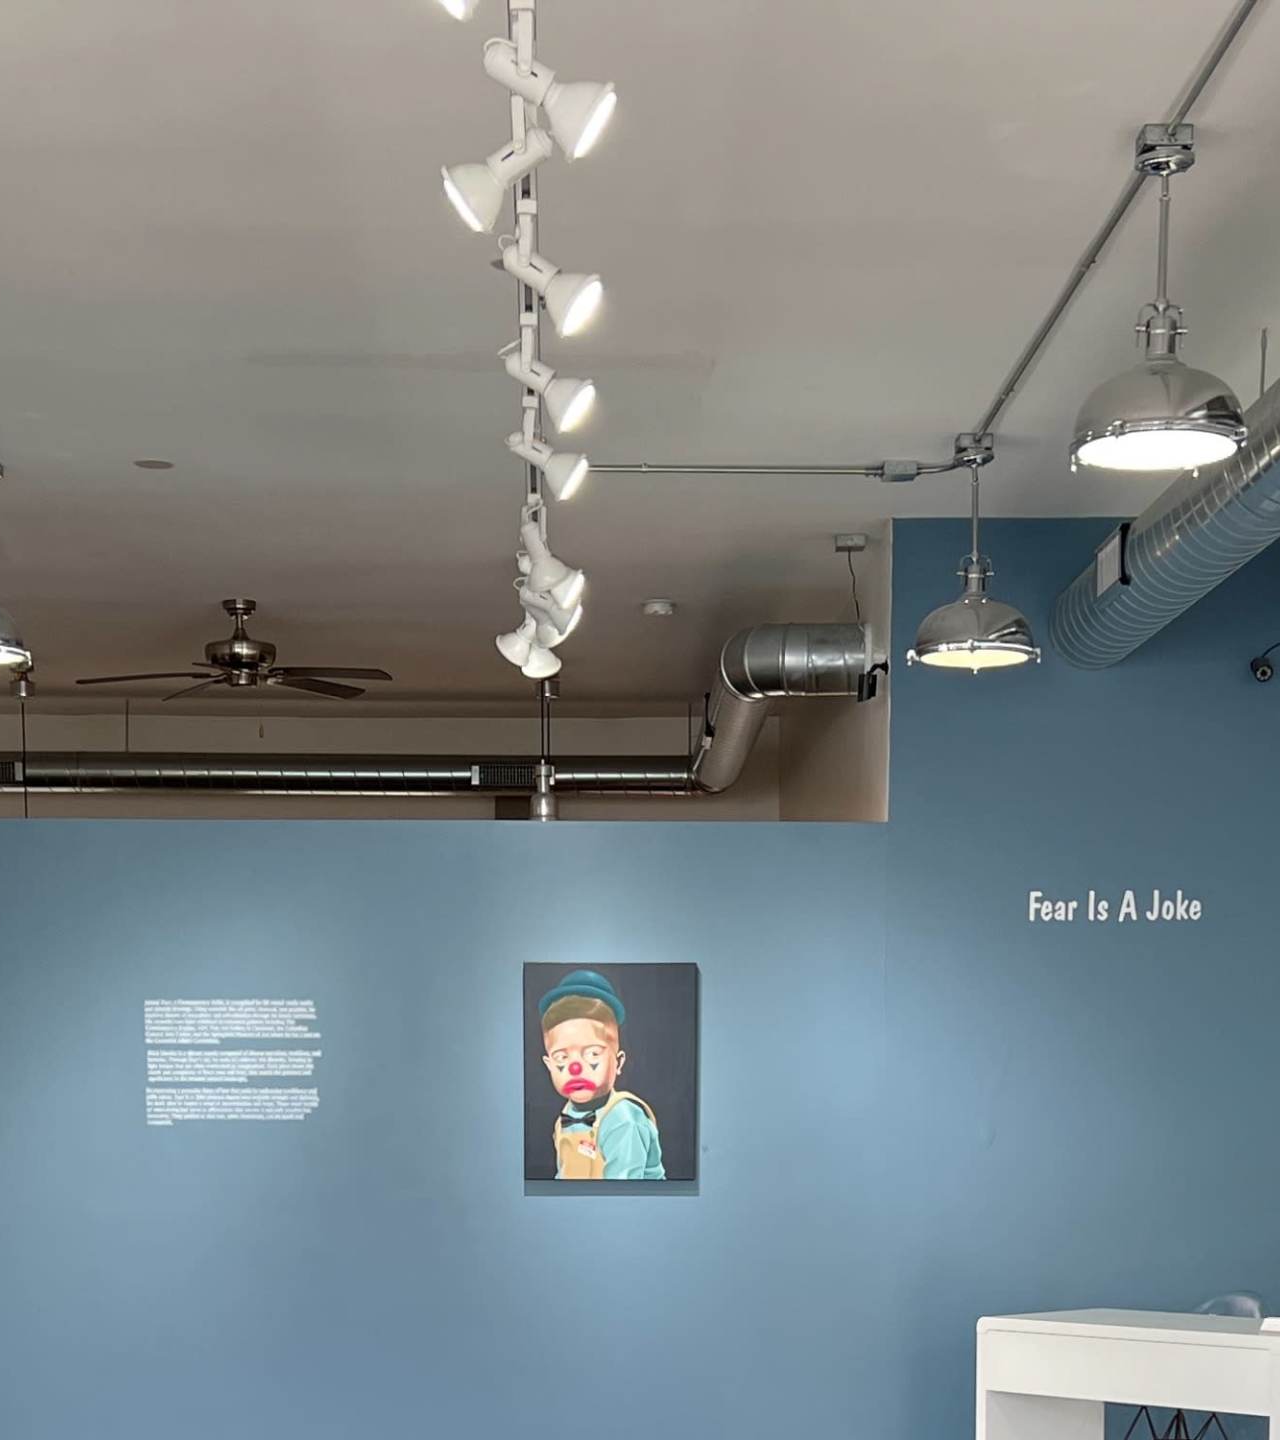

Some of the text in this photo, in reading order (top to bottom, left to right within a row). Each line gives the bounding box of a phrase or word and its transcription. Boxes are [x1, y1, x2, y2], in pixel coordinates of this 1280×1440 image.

[1028, 889, 1202, 923] Fear Is A Joke
